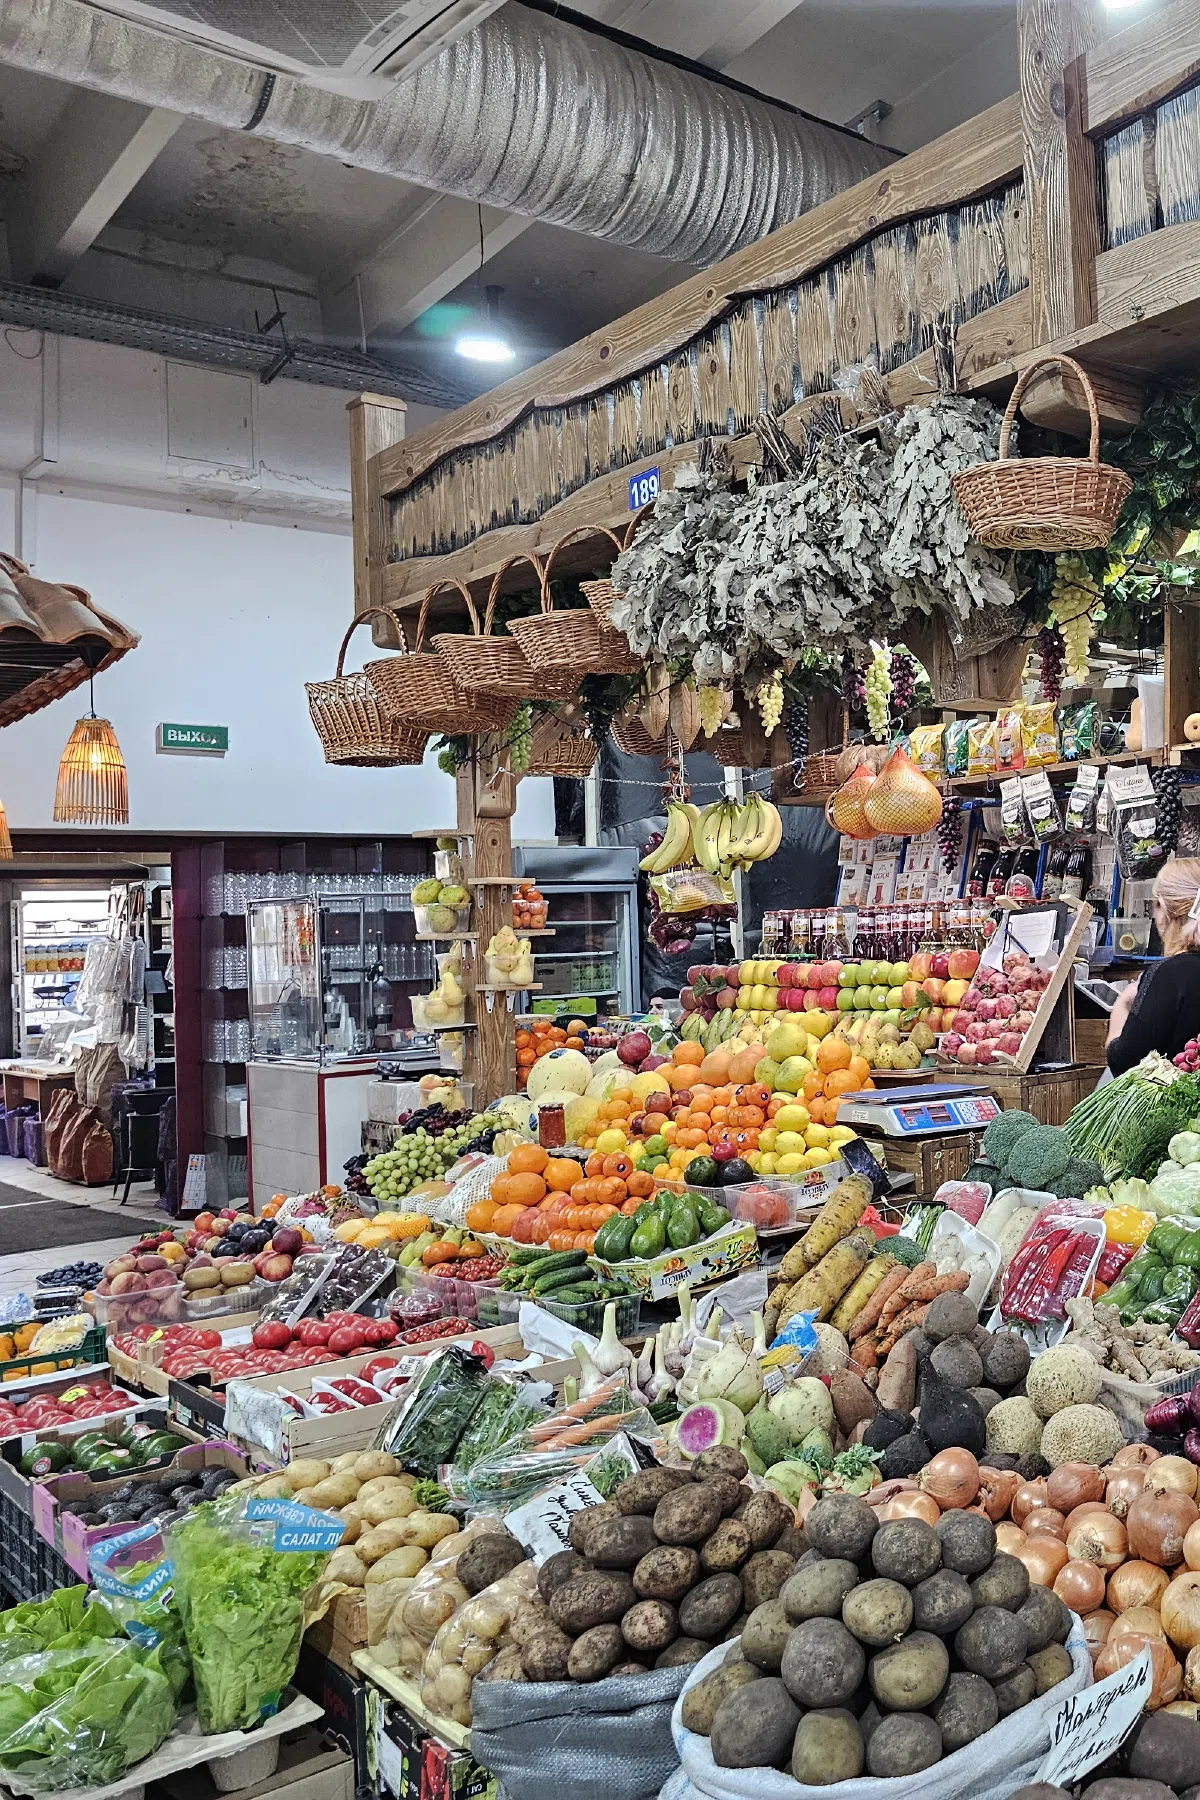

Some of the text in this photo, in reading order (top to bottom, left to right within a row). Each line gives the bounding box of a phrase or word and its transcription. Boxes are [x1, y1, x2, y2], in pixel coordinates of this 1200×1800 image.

[631, 474, 658, 507] 189
[800, 1182, 829, 1196] APRICOT
[660, 1267, 693, 1286] APRICOT
[281, 1532, 322, 1547] САЛАТ
